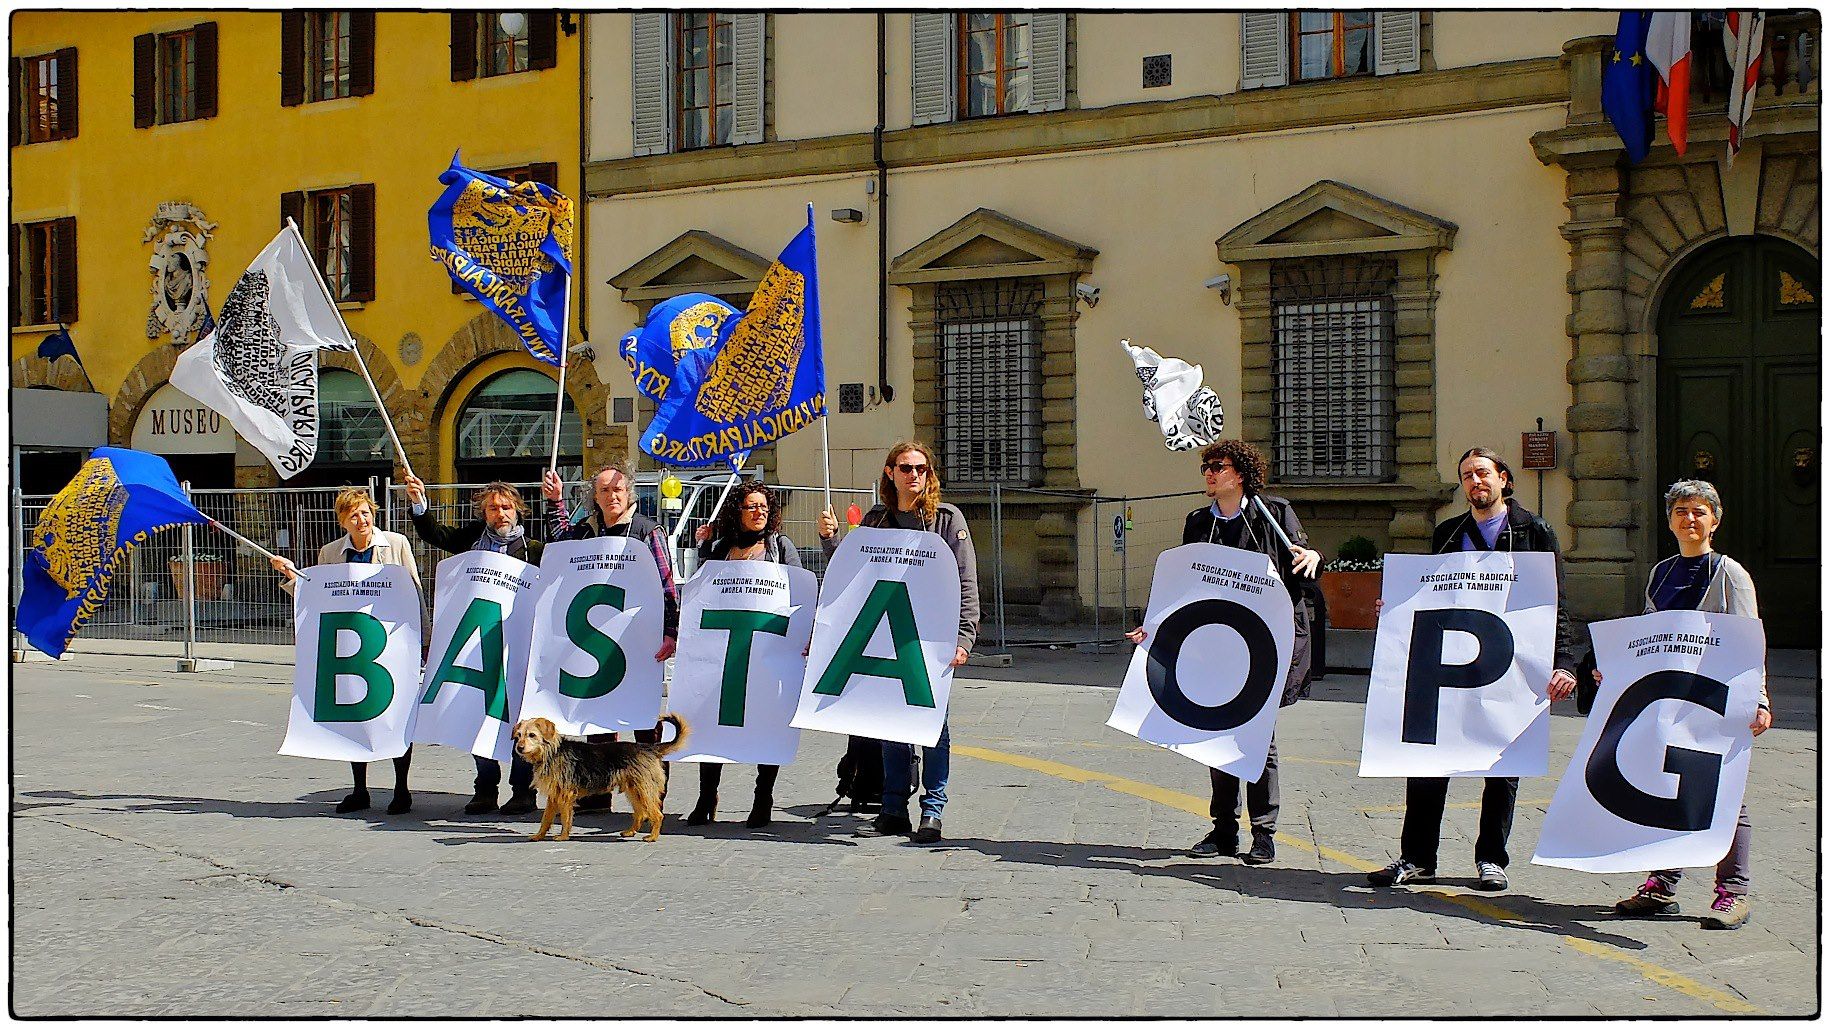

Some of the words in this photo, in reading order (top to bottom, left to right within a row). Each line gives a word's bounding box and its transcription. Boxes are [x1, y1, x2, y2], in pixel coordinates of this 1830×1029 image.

[151, 409, 220, 434] MUSEO
[860, 545, 903, 555] ASSOCIAZIONE
[905, 548, 937, 559] RADICALE
[869, 555, 893, 563] ANDREA
[894, 557, 925, 567] TAMBURI
[361, 580, 393, 589] RADICALE
[712, 578, 753, 586] ASSOCIAZIONE
[754, 578, 786, 589] RADICALE
[1191, 562, 1242, 580] ASSOCIAZIONE
[1243, 573, 1275, 587] RADICALE
[1201, 574, 1229, 587] ANDREA
[1231, 581, 1263, 595] TAMBURI
[1420, 572, 1476, 583] ASSOCIAZIONE
[1479, 573, 1519, 582] RADICALE
[721, 586, 743, 594] ANDREA
[745, 586, 774, 596] TAMBURI
[1433, 582, 1464, 592] ANDREA
[1466, 582, 1503, 591] TAMBURI
[559, 583, 627, 699] S
[812, 579, 936, 708] A
[1627, 633, 1674, 649] ASSOCIAZIONE
[1676, 633, 1721, 647] RADICALE
[1635, 646, 1660, 658] ANDREA
[1663, 644, 1703, 656] TAMBURI
[313, 611, 395, 722] B
[419, 597, 510, 723] A
[700, 608, 790, 727] T
[1146, 599, 1279, 731] O
[1401, 608, 1515, 745] P
[1585, 669, 1730, 831] G
